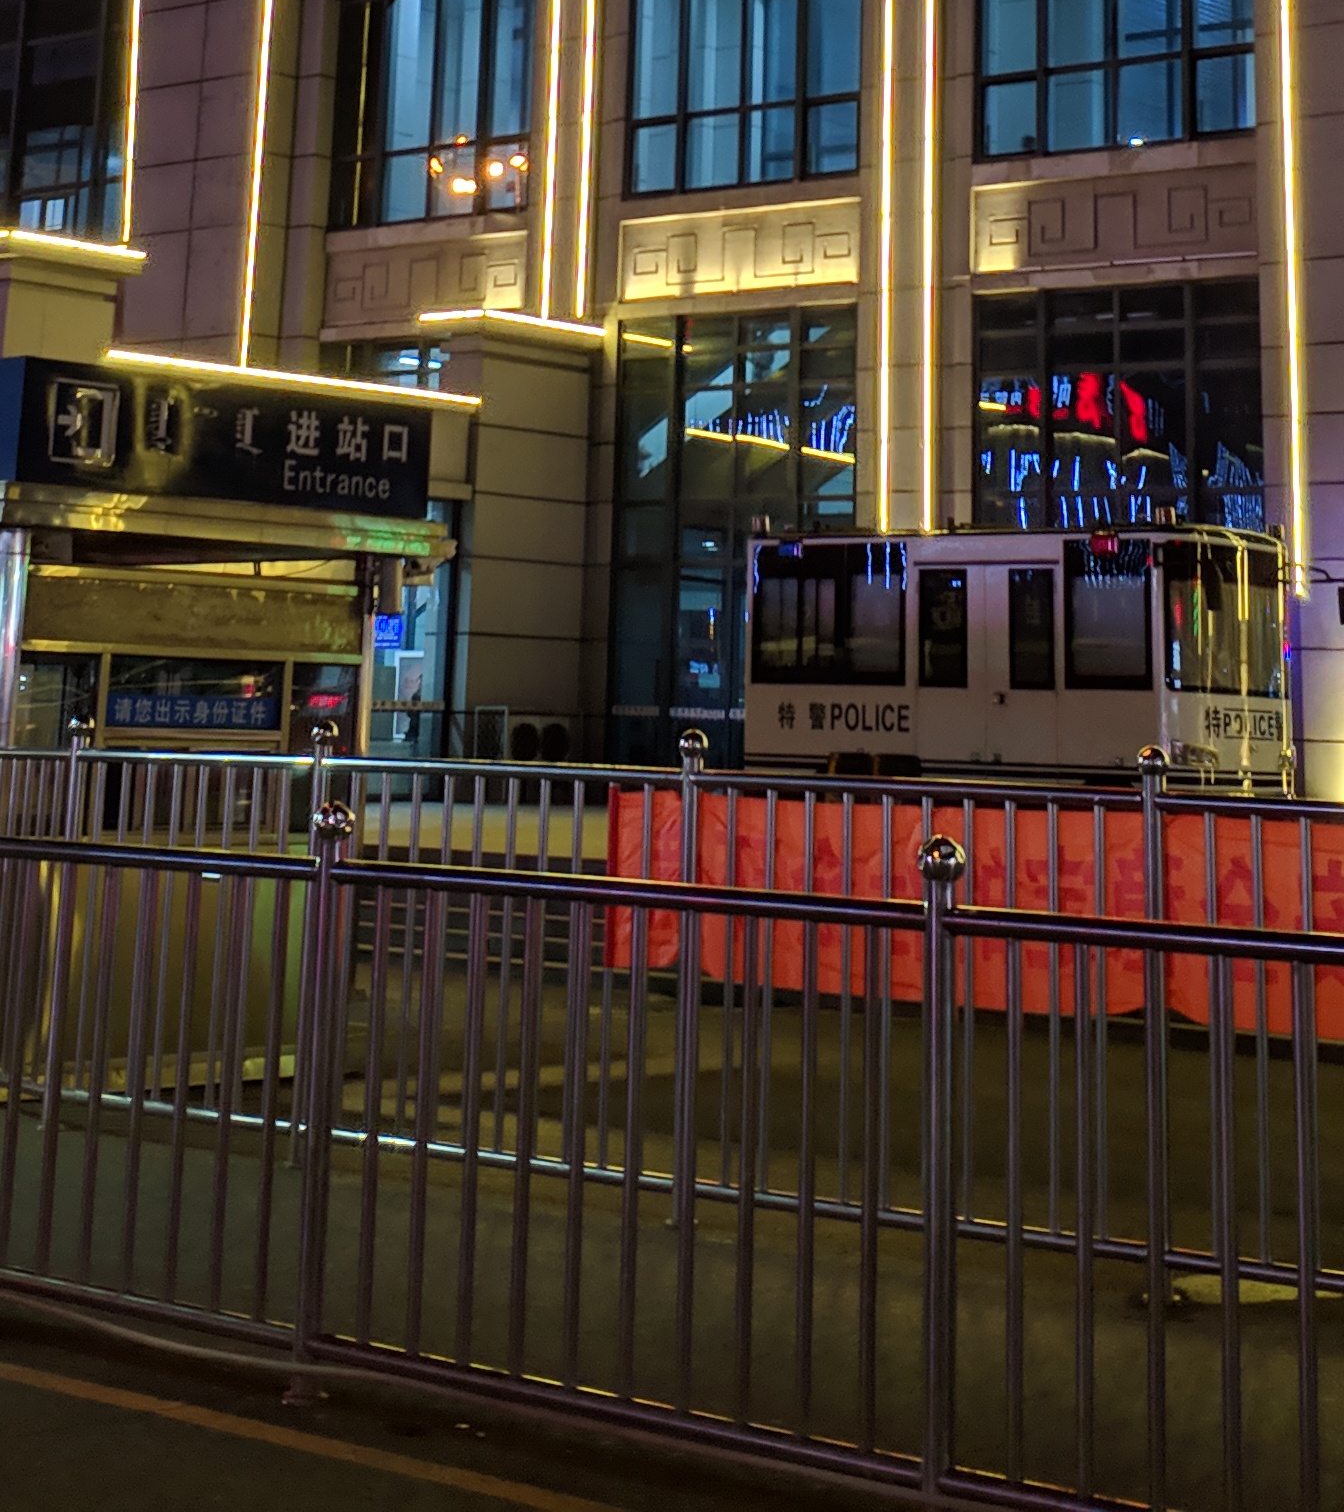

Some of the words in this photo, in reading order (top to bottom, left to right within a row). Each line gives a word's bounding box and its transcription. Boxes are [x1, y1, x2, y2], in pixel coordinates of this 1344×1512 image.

[286, 410, 409, 463] 进站口
[283, 459, 392, 500] Entrance
[113, 697, 267, 726] 请您出示身份证件
[830, 702, 911, 733] POLICE
[1223, 713, 1274, 737] POICE
